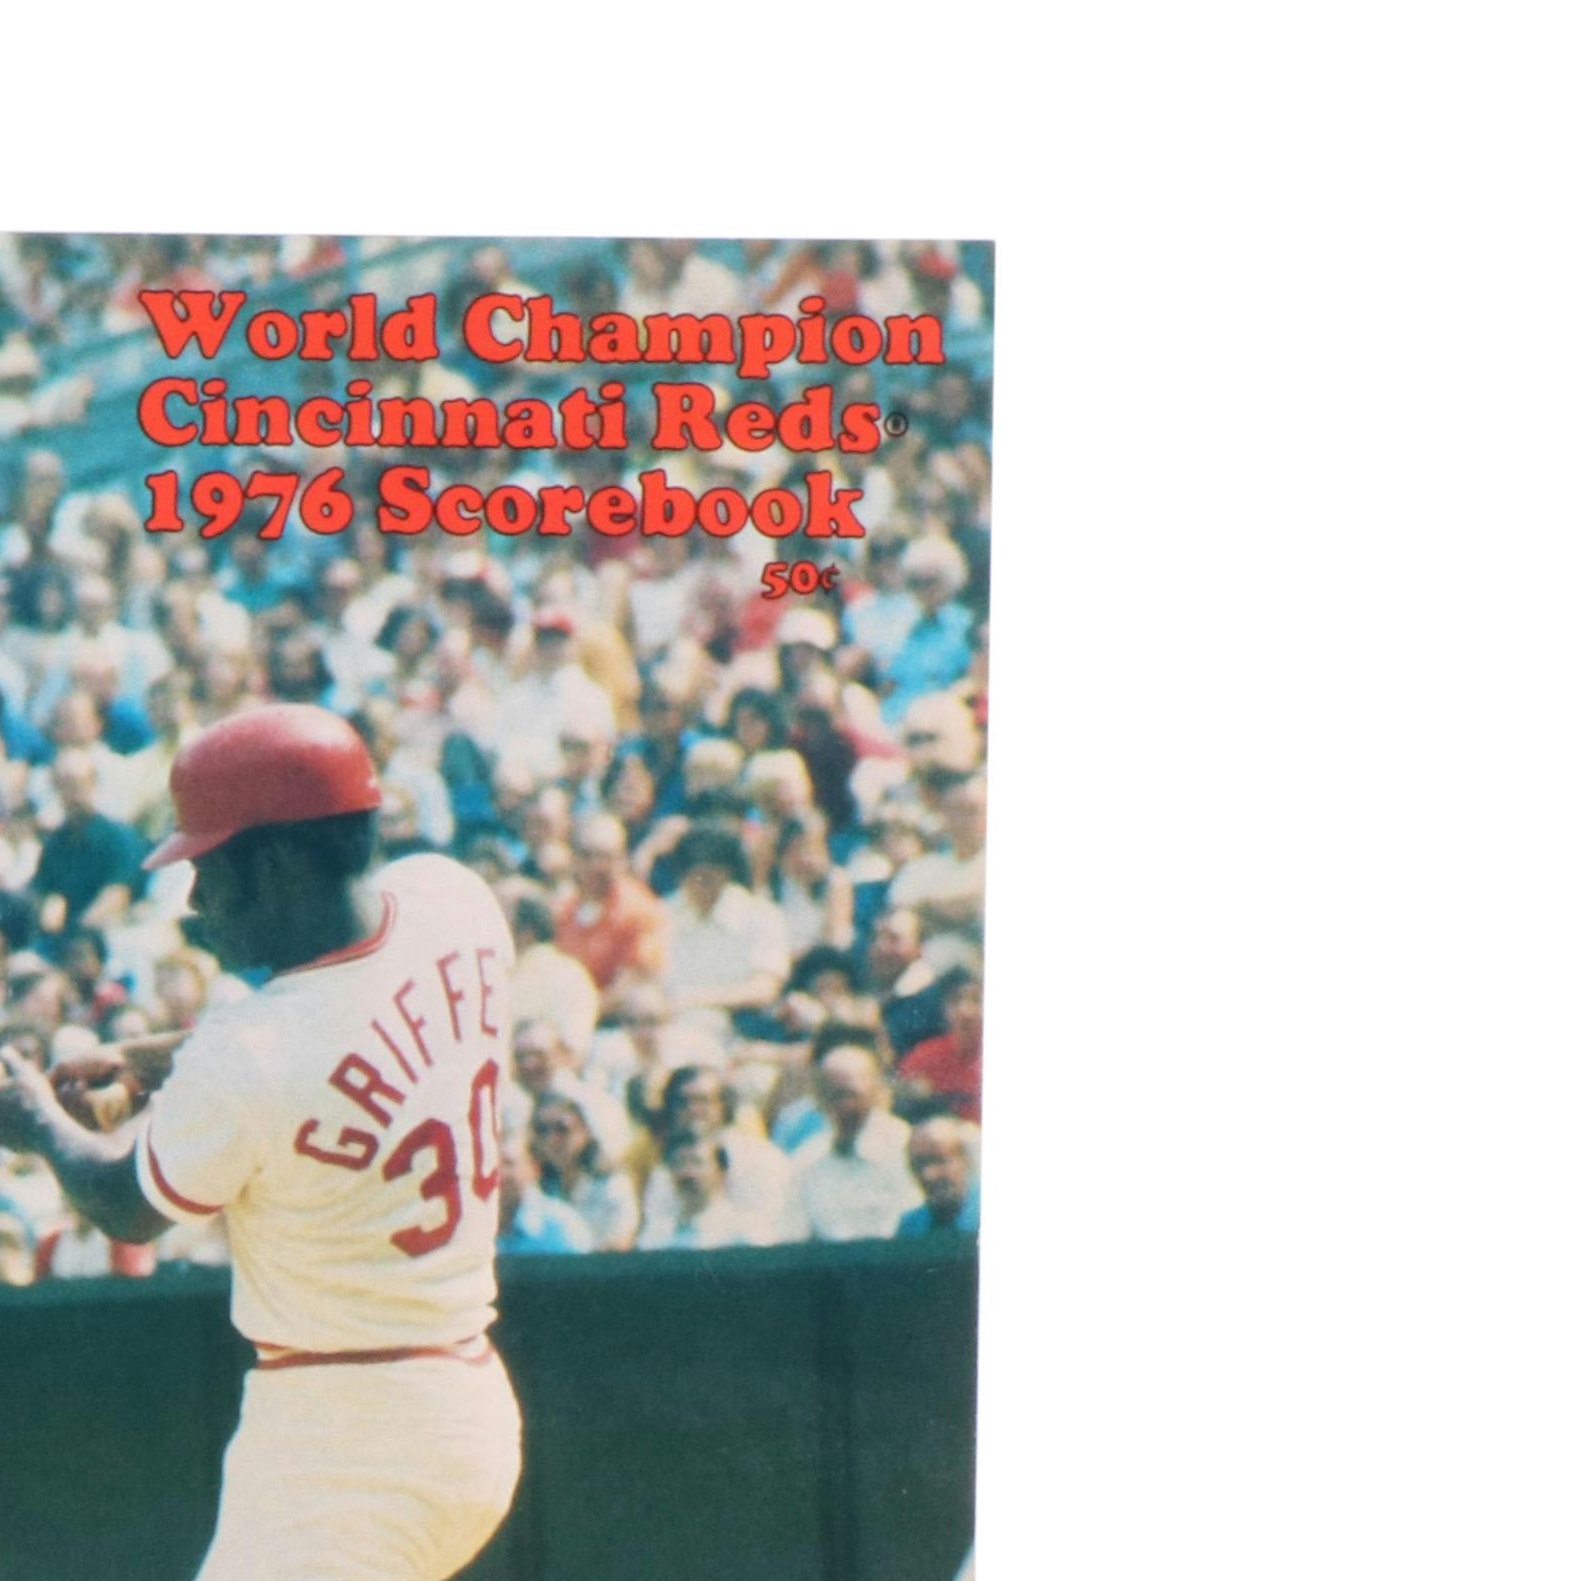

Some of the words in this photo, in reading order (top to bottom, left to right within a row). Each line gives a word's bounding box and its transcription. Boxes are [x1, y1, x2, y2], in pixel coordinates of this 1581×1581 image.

[137, 290, 440, 363] World
[462, 291, 947, 380] Champion
[137, 376, 629, 449] Cincinnati
[144, 468, 356, 541] 1976
[375, 464, 867, 539] Scorebook
[760, 560, 841, 601] 50¢
[381, 1057, 501, 1258] 30
